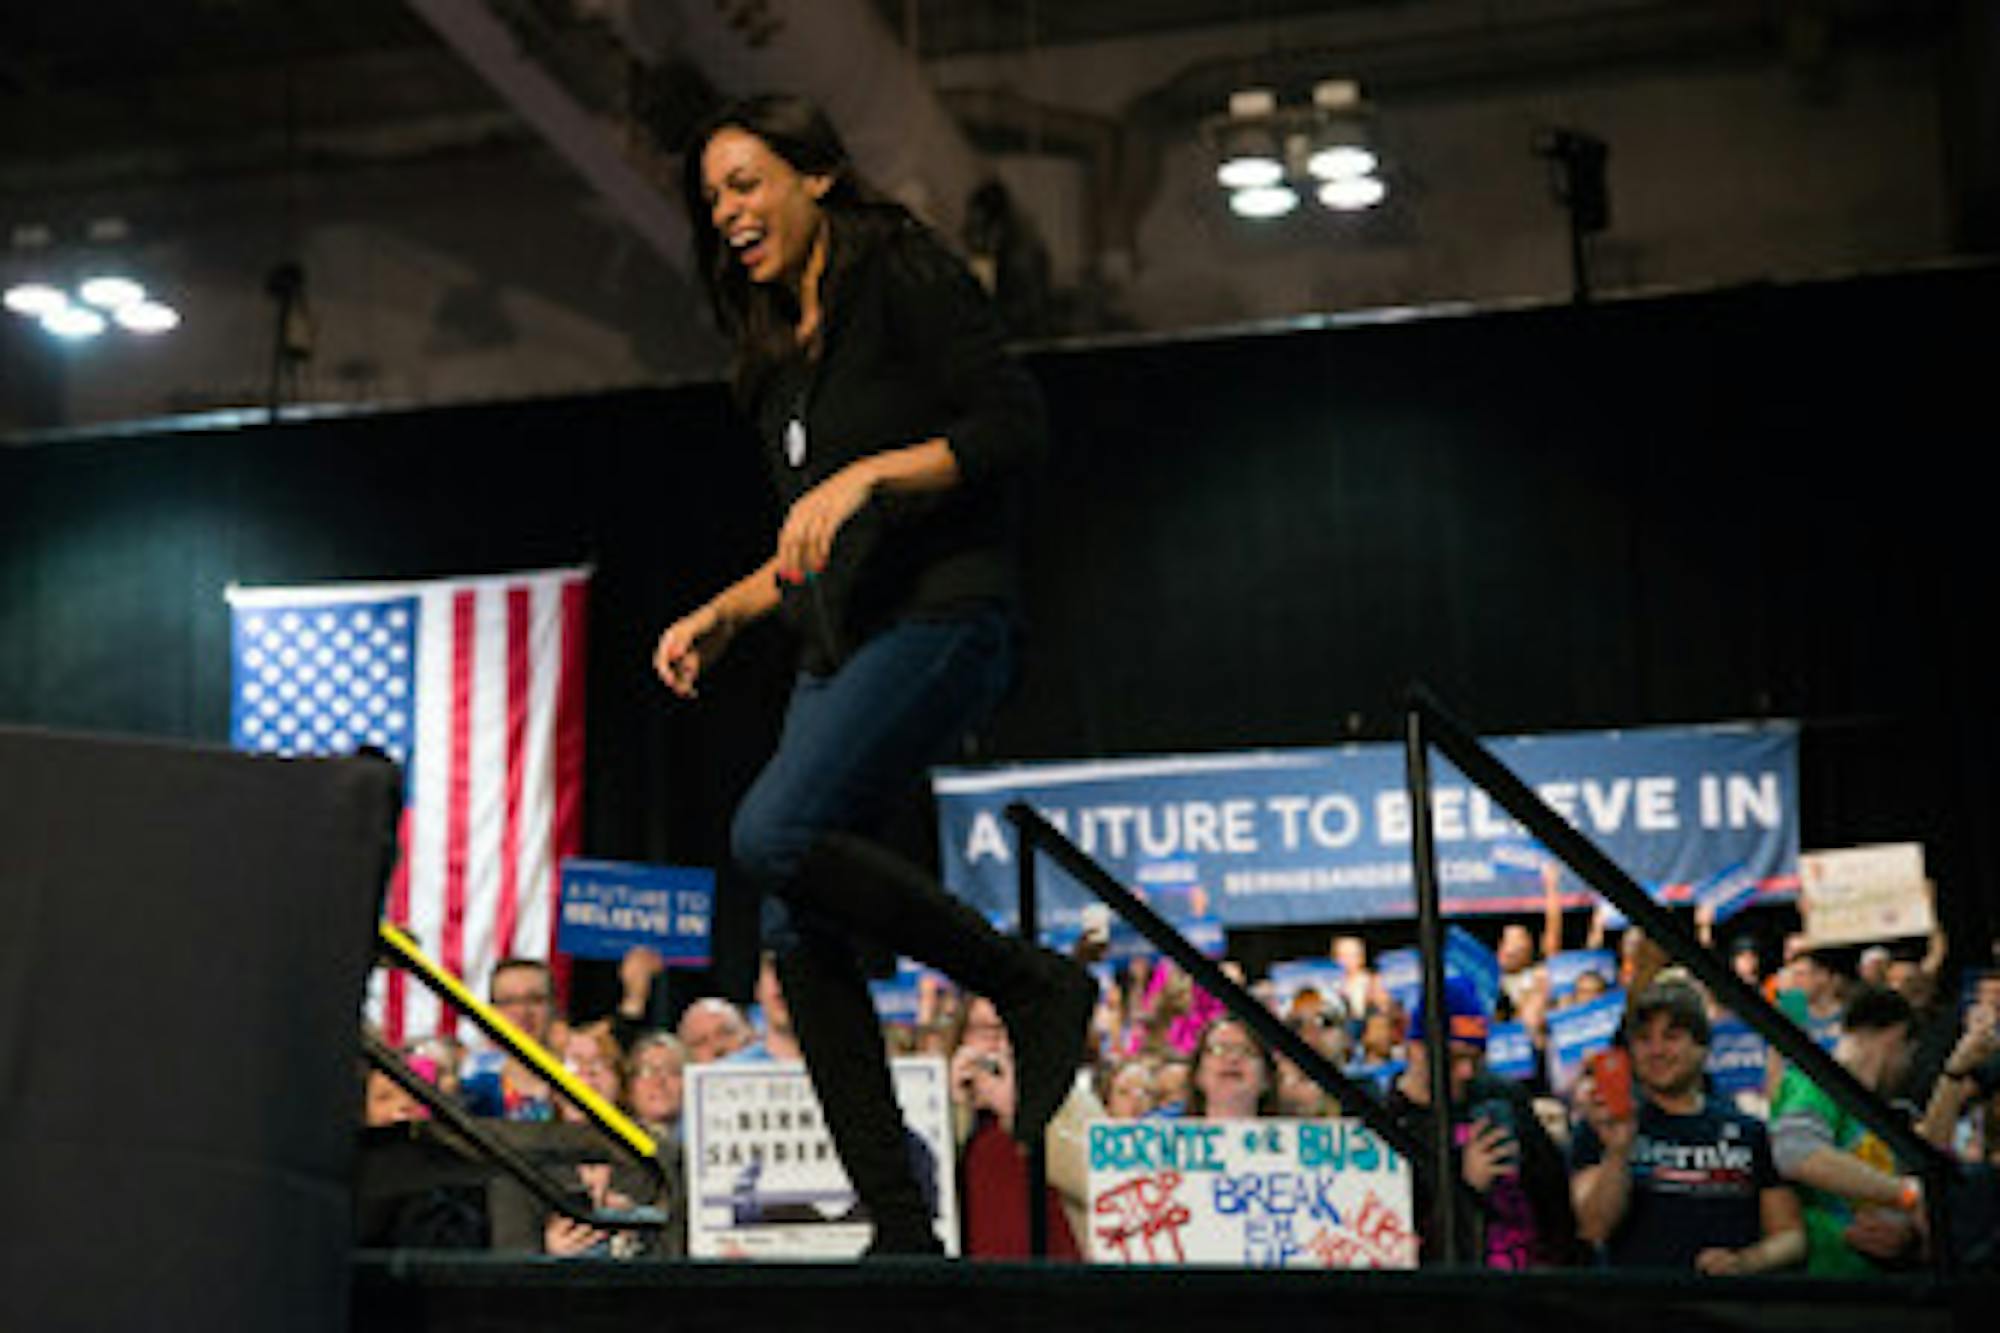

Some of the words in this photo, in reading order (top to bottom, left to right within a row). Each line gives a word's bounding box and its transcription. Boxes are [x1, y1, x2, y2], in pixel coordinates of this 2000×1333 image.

[967, 809, 1009, 862] A
[1038, 798, 1257, 858] UTURE
[1270, 795, 1360, 847] TO
[1375, 776, 1680, 846] BELEVE
[1702, 772, 1780, 829] IN
[705, 1140, 830, 1168] SANDER
[1090, 1123, 1226, 1172] BERNIE
[1211, 1172, 1342, 1226] BREAK
